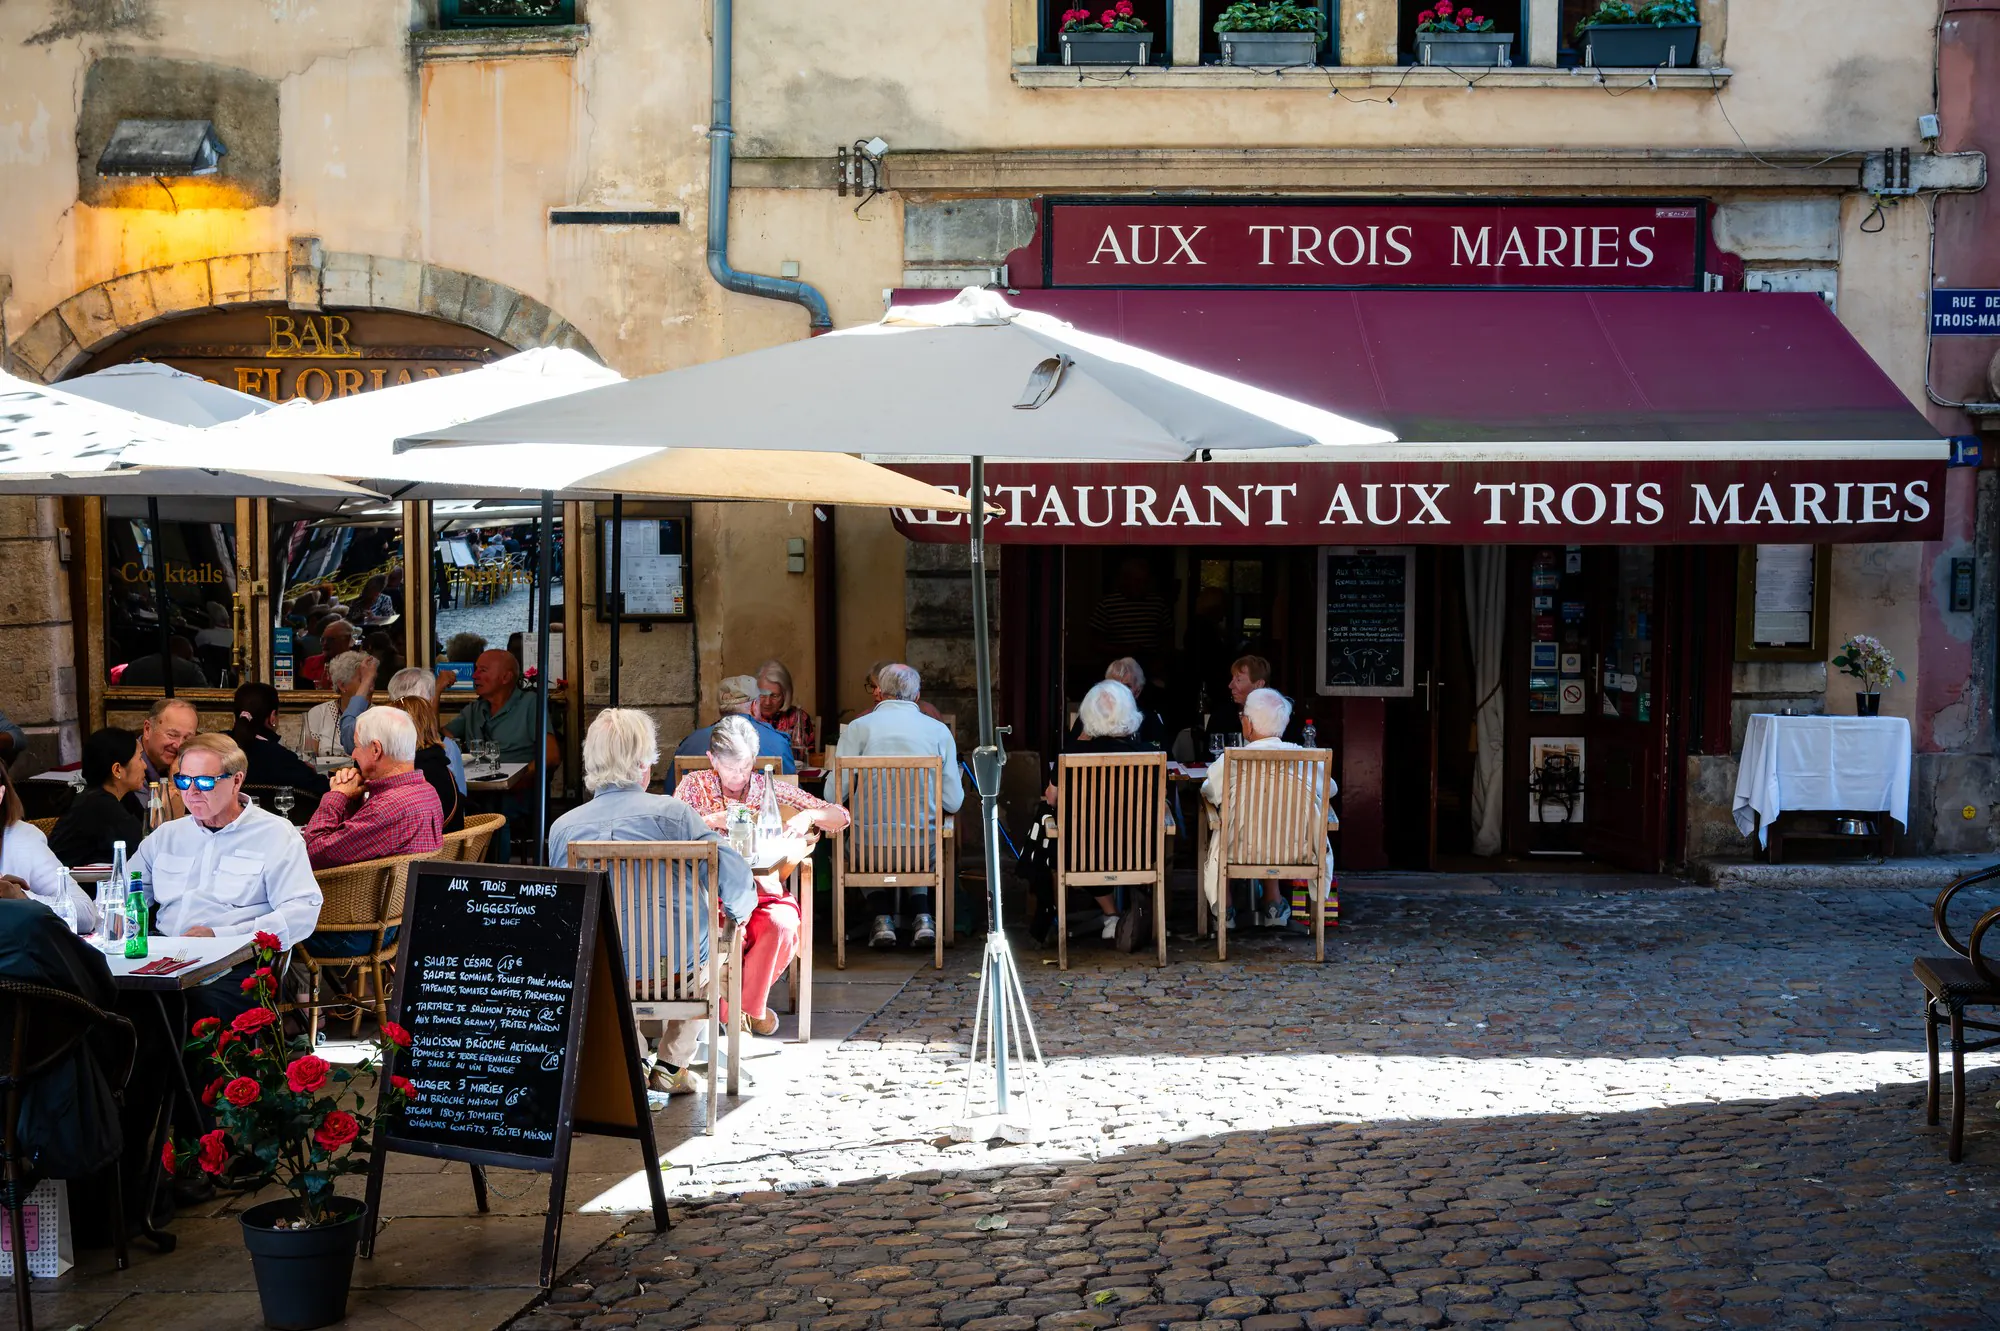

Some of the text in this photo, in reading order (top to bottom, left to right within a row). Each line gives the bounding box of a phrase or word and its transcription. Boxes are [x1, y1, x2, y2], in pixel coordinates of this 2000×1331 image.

[1087, 225, 1656, 269] AUX TROIS MARIES
[1952, 296, 1976, 308] RUE
[265, 315, 360, 356] BAR
[1319, 483, 1450, 526] AUX
[1474, 482, 1664, 525] TROIS
[1689, 480, 1931, 525] MARIES
[463, 564, 534, 591] Spirits
[448, 878, 558, 897] AUX TROIS MARIES
[466, 900, 536, 915] SUGGESTIONS
[482, 917, 521, 926] DU CHEF
[424, 956, 459, 967] SALADE
[464, 954, 494, 968] CÉSAR
[423, 970, 456, 980] SALADE
[497, 973, 525, 984] POULET
[527, 973, 547, 987] PANÉ
[547, 976, 573, 989] MAISON
[459, 986, 489, 996] TOMATES
[524, 990, 566, 1002] PARMESAN
[416, 1001, 454, 1012] TARTARE
[456, 1003, 467, 1012] DE
[471, 1003, 503, 1014] SAUMON
[506, 1005, 531, 1018] FRAIS
[415, 1015, 430, 1025] AUX
[432, 1014, 462, 1025] POMMES
[501, 1018, 527, 1030] FRITES
[528, 1021, 560, 1032] MAISON
[412, 1034, 461, 1048] SAUCISSON
[465, 1034, 506, 1050] BRIOCHÉ
[510, 1039, 552, 1054] ARTISANAL
[411, 1047, 444, 1058] POMMES
[458, 1052, 478, 1061] TERRE
[479, 1053, 522, 1064] GRENAILLES
[411, 1059, 516, 1074] ET SAUCE AU VIN ROUGE
[409, 1078, 503, 1094] BURGER 3 MARIES
[430, 1093, 465, 1105] BRIOCHÉ
[467, 1095, 499, 1107] MAISON
[409, 1119, 447, 1130] OIGNONS
[492, 1126, 521, 1137] FRITES
[523, 1129, 553, 1141] MAISON
